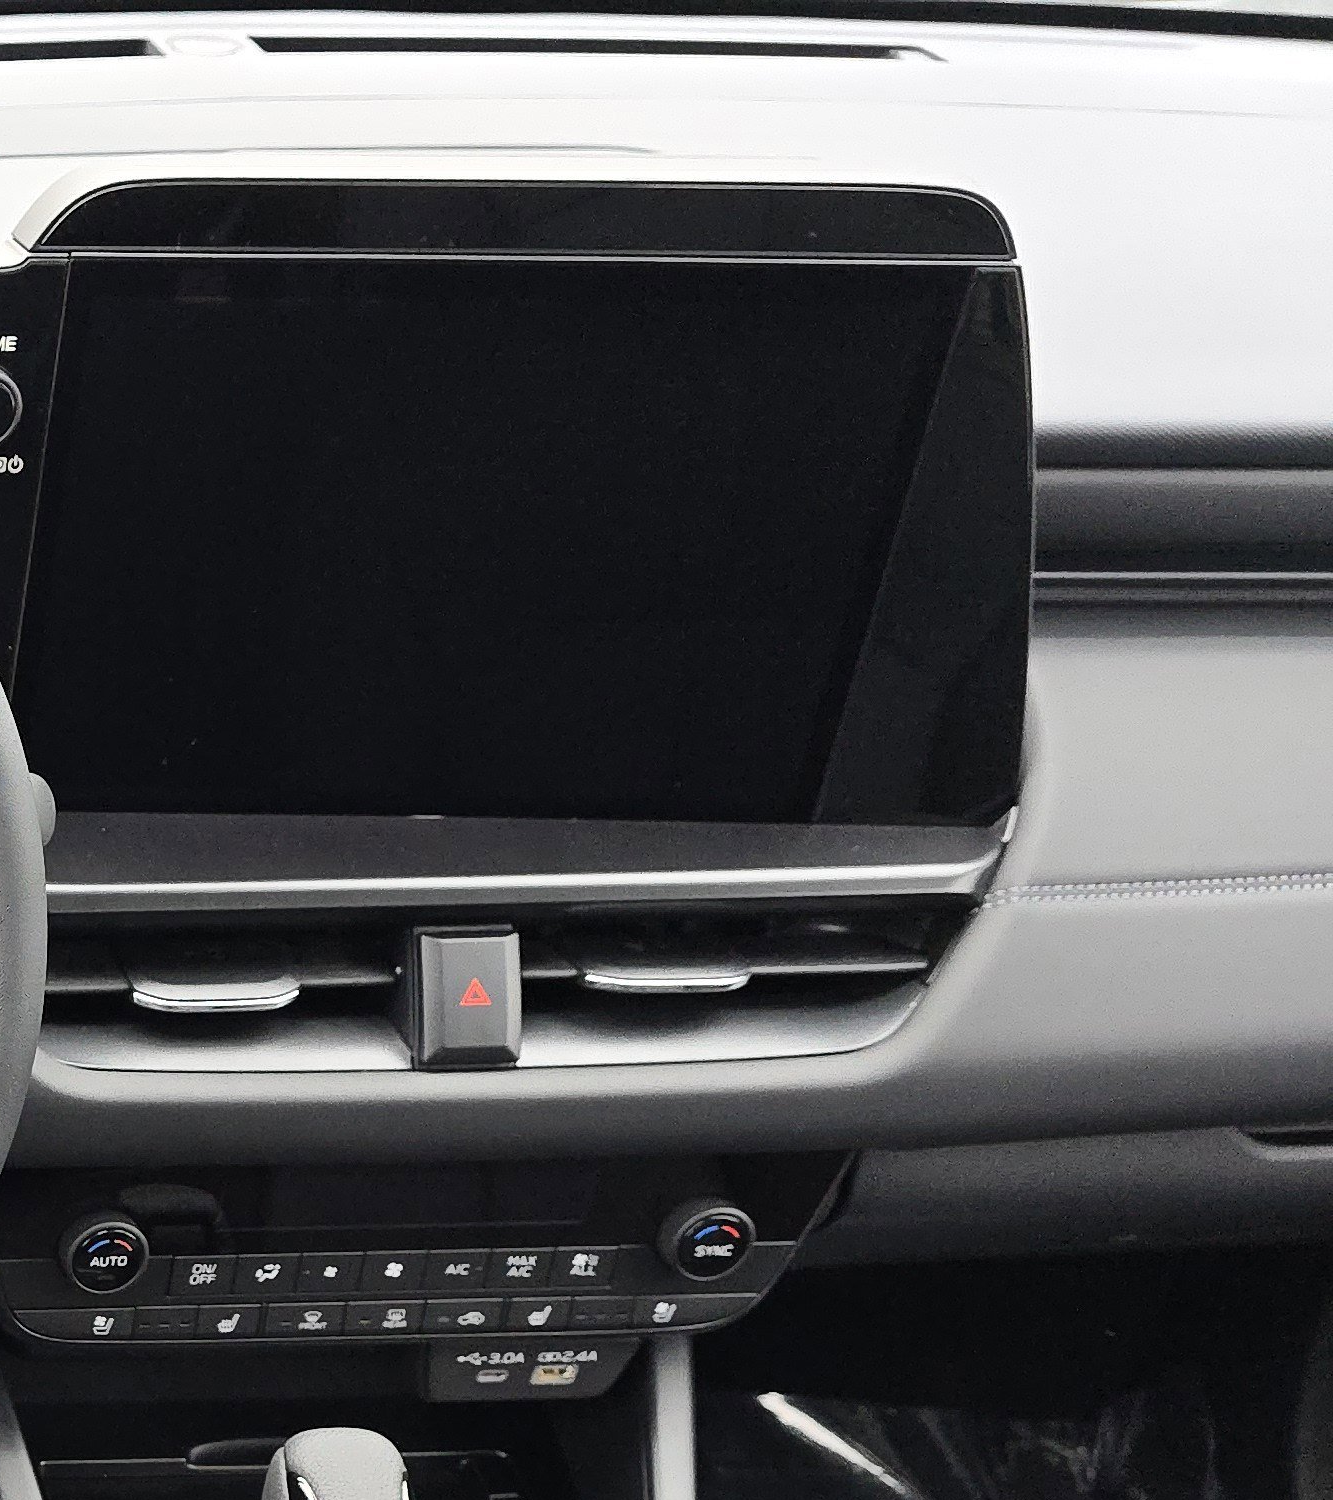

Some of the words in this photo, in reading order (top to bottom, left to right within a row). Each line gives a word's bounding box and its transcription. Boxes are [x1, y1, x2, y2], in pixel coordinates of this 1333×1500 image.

[90, 1255, 128, 1267] AUTO
[192, 1263, 217, 1274] ON/
[570, 1265, 596, 1276] ALL
[189, 1274, 217, 1286] OFF
